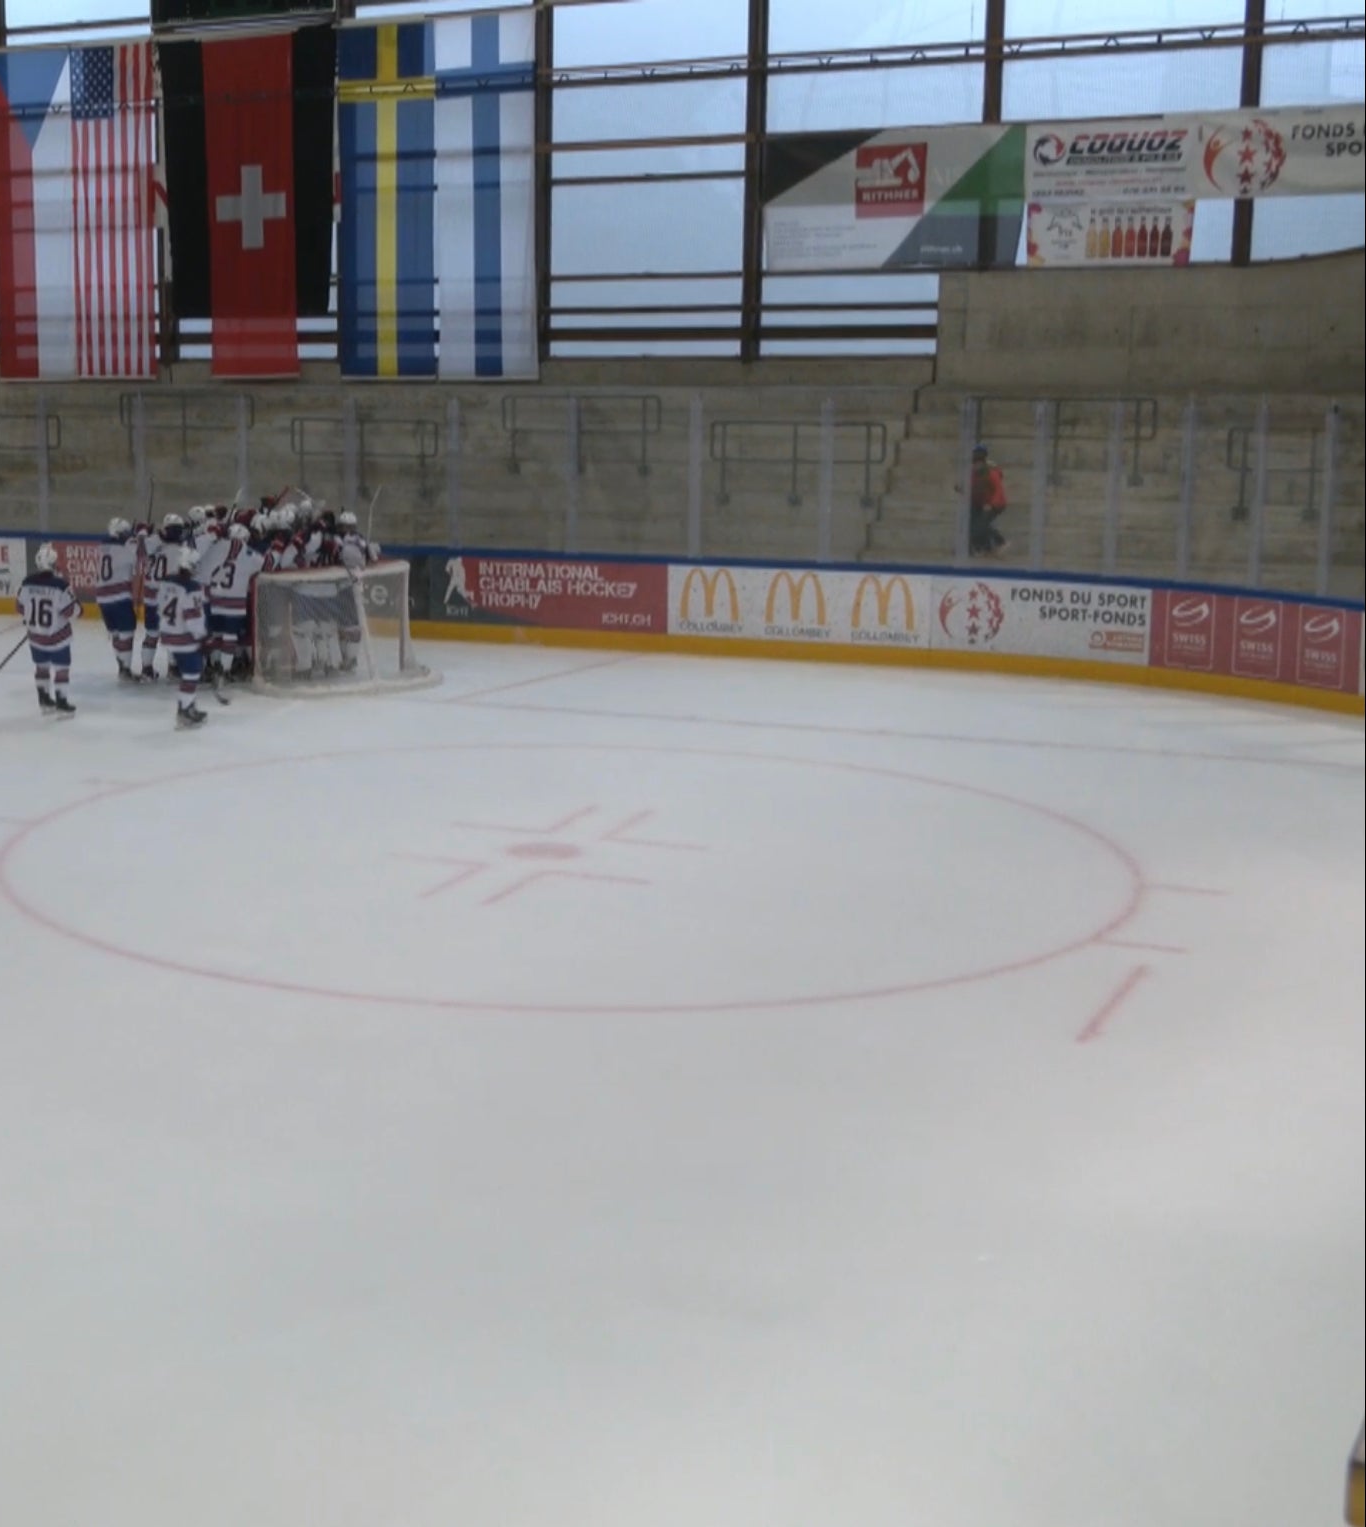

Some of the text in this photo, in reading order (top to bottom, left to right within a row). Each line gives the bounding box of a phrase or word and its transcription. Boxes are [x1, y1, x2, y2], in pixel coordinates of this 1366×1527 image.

[1069, 130, 1188, 155] COQUOZ
[1292, 123, 1355, 140] FONDS
[478, 561, 604, 582] INTERNATIONAL
[479, 577, 638, 599] CHABLAIS HOCKEY
[1011, 587, 1146, 610] FONDS DU SPORT
[480, 591, 542, 610] TROPHY
[29, 597, 53, 628] 16
[1039, 605, 1147, 627] SPORT-FONDS
